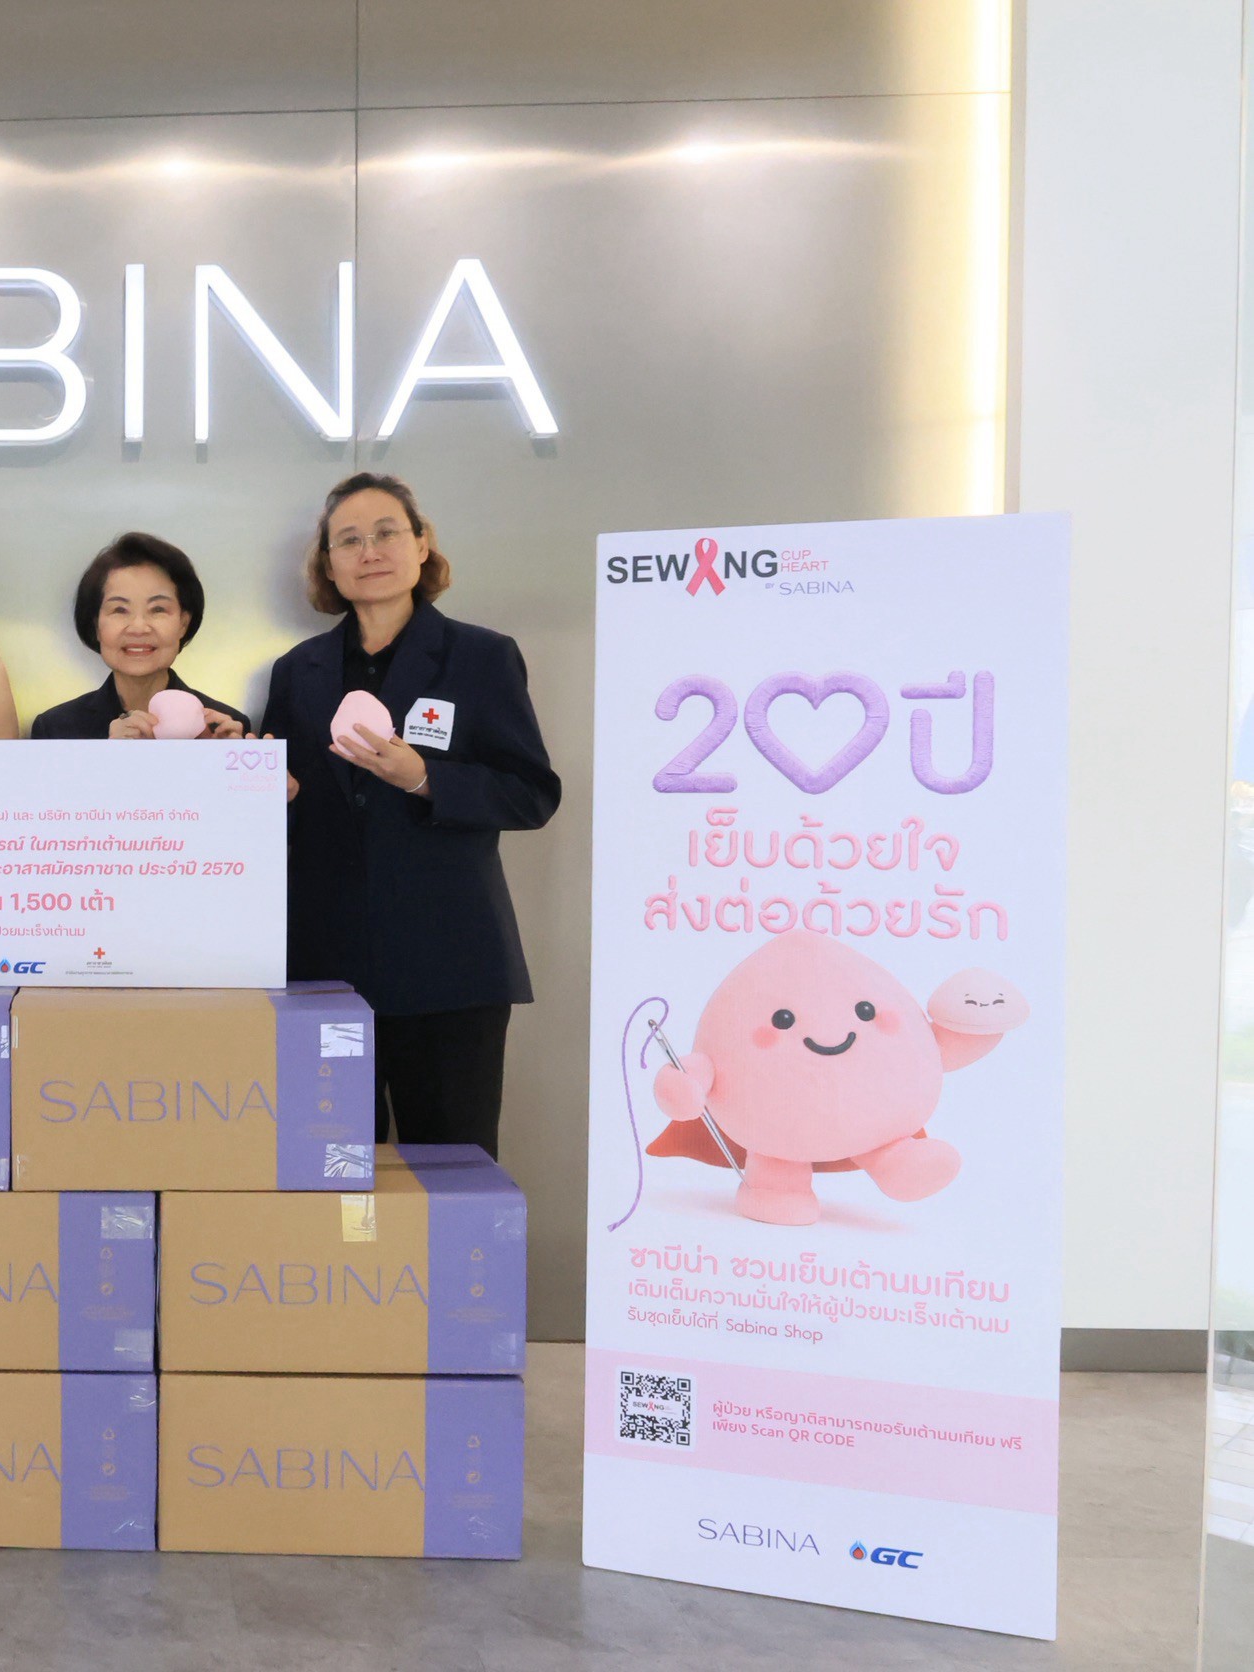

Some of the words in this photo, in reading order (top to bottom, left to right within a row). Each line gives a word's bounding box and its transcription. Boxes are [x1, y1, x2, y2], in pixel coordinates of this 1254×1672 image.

[780, 549, 812, 562] CUP
[780, 560, 829, 573] HEART
[779, 579, 855, 596] SABINA
[13, 810, 34, 821] และ
[38, 809, 71, 821] บริษัท
[116, 809, 164, 821] ฟาร์อีสท์
[168, 809, 199, 821] จำกัด
[30, 834, 185, 852] ในการทำเต้านมเทียม
[689, 807, 960, 871] เย็บด้วยใจ
[138, 860, 198, 875] ประจำปี
[202, 862, 245, 875] 2570
[10, 893, 72, 914] 1,500
[81, 888, 115, 911] เต้า
[644, 874, 1008, 941] ส่งต่อด้วยรัก
[13, 961, 46, 974] GC
[39, 1079, 278, 1125] SABINA
[189, 1262, 428, 1306] SABINA
[628, 1244, 718, 1275] ซาบีน่า
[731, 1252, 1009, 1303] ชวนเย็บเต้านมเทียม
[628, 1277, 1010, 1334] เติมเต็มความมั่นใจให้ผู้ป่วยมะเร็งเต้านม
[627, 1306, 718, 1329] รับชุดเย็บได้ที่
[725, 1318, 778, 1337] Sabina
[784, 1325, 823, 1344] Shop
[712, 1399, 752, 1417] ผู้ป่วย
[1000, 1435, 1023, 1451] ฟรี
[712, 1418, 746, 1433] เพียง
[751, 1424, 785, 1440] Scan
[788, 1427, 810, 1443] QR
[814, 1431, 855, 1448] CODE
[187, 1445, 425, 1492] SABINA
[697, 1517, 821, 1555] SABINA
[869, 1546, 924, 1569] GC
